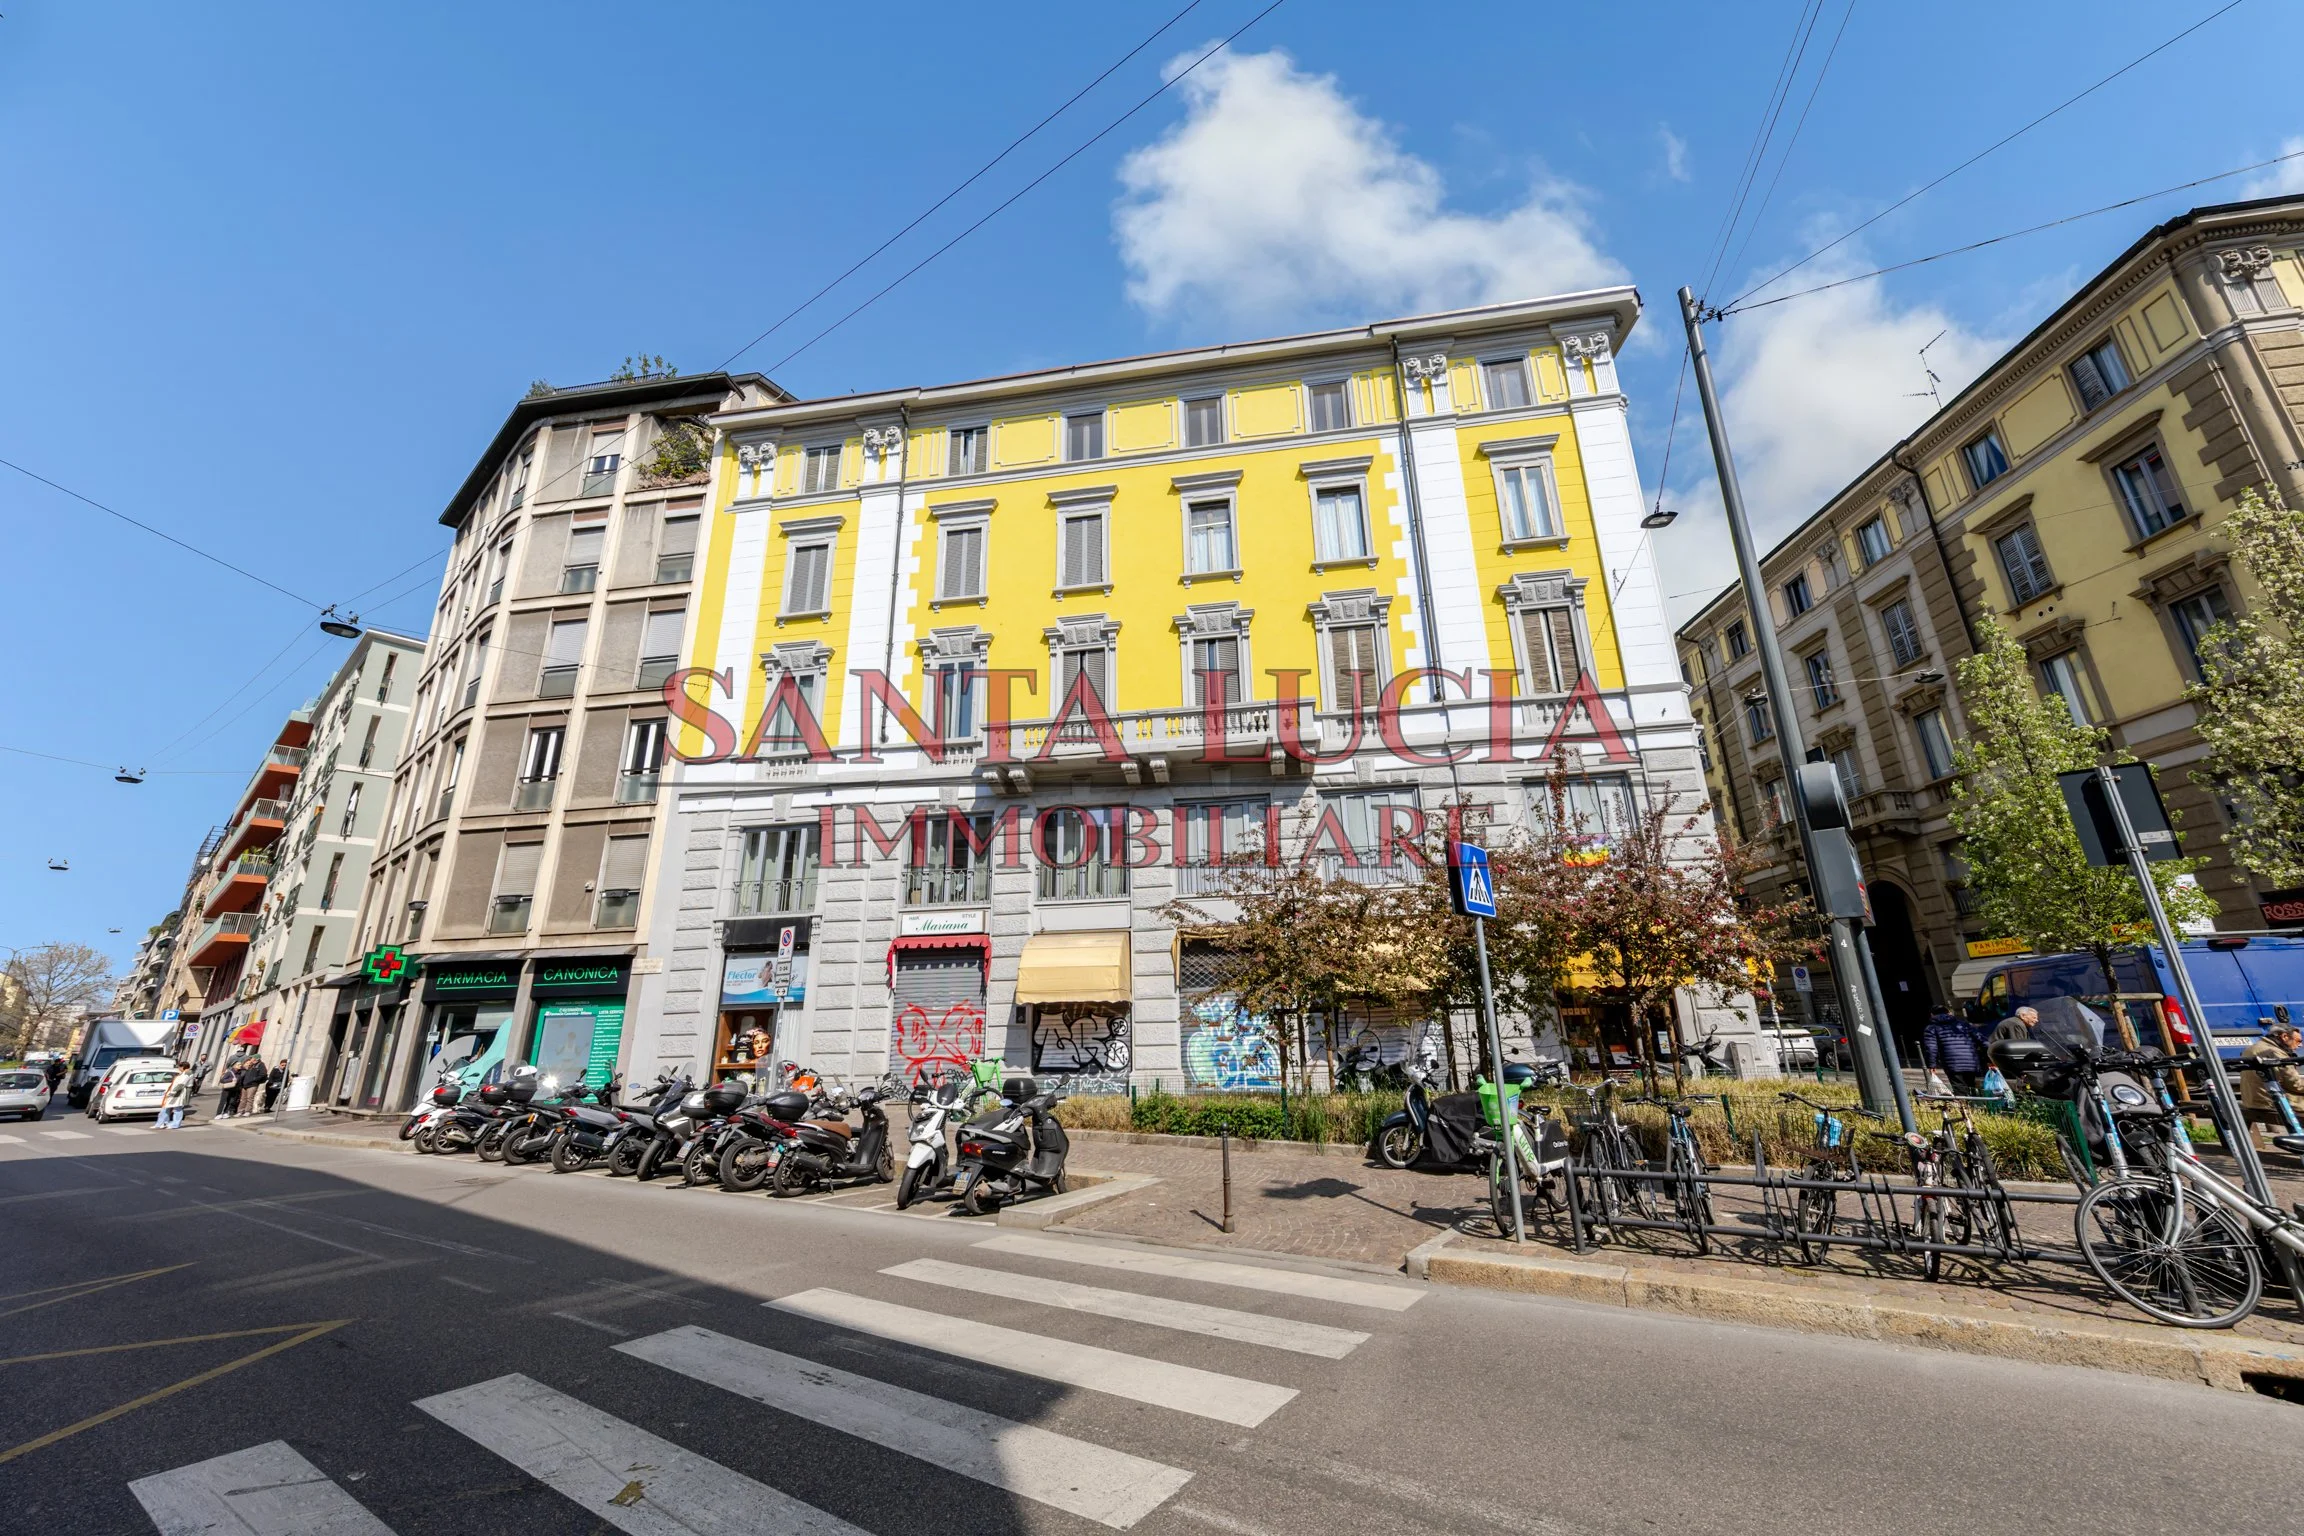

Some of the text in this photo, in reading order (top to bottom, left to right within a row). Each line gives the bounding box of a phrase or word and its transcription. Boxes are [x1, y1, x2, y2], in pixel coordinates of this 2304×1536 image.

[915, 919, 969, 931] Mariana
[1840, 938, 1848, 948] 4
[436, 971, 508, 985] FARMACIA
[543, 966, 619, 981] CANONICA
[727, 970, 757, 980] Flector
